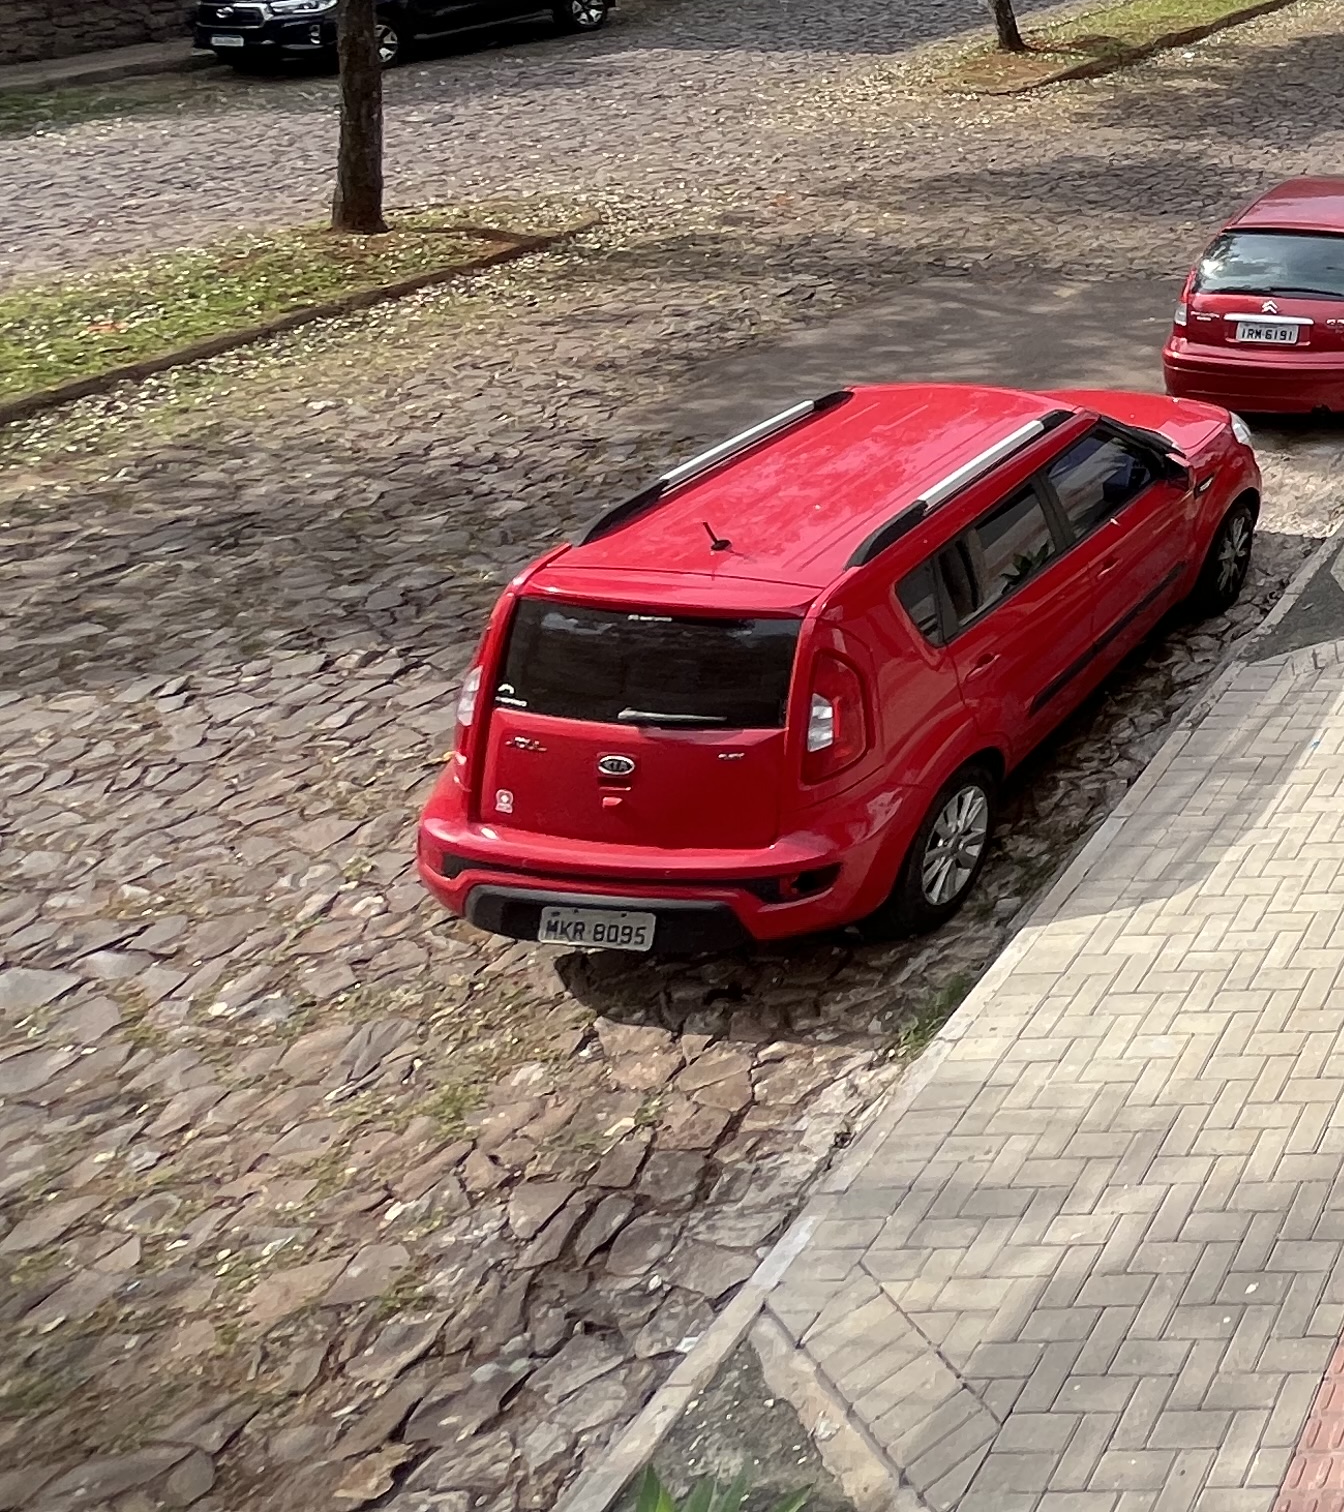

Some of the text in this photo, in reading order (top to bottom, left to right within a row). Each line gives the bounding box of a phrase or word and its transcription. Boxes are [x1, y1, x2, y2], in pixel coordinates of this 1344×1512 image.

[1264, 329, 1293, 341] 6191
[602, 759, 630, 772] KIA
[545, 919, 647, 945] MKR 8095
